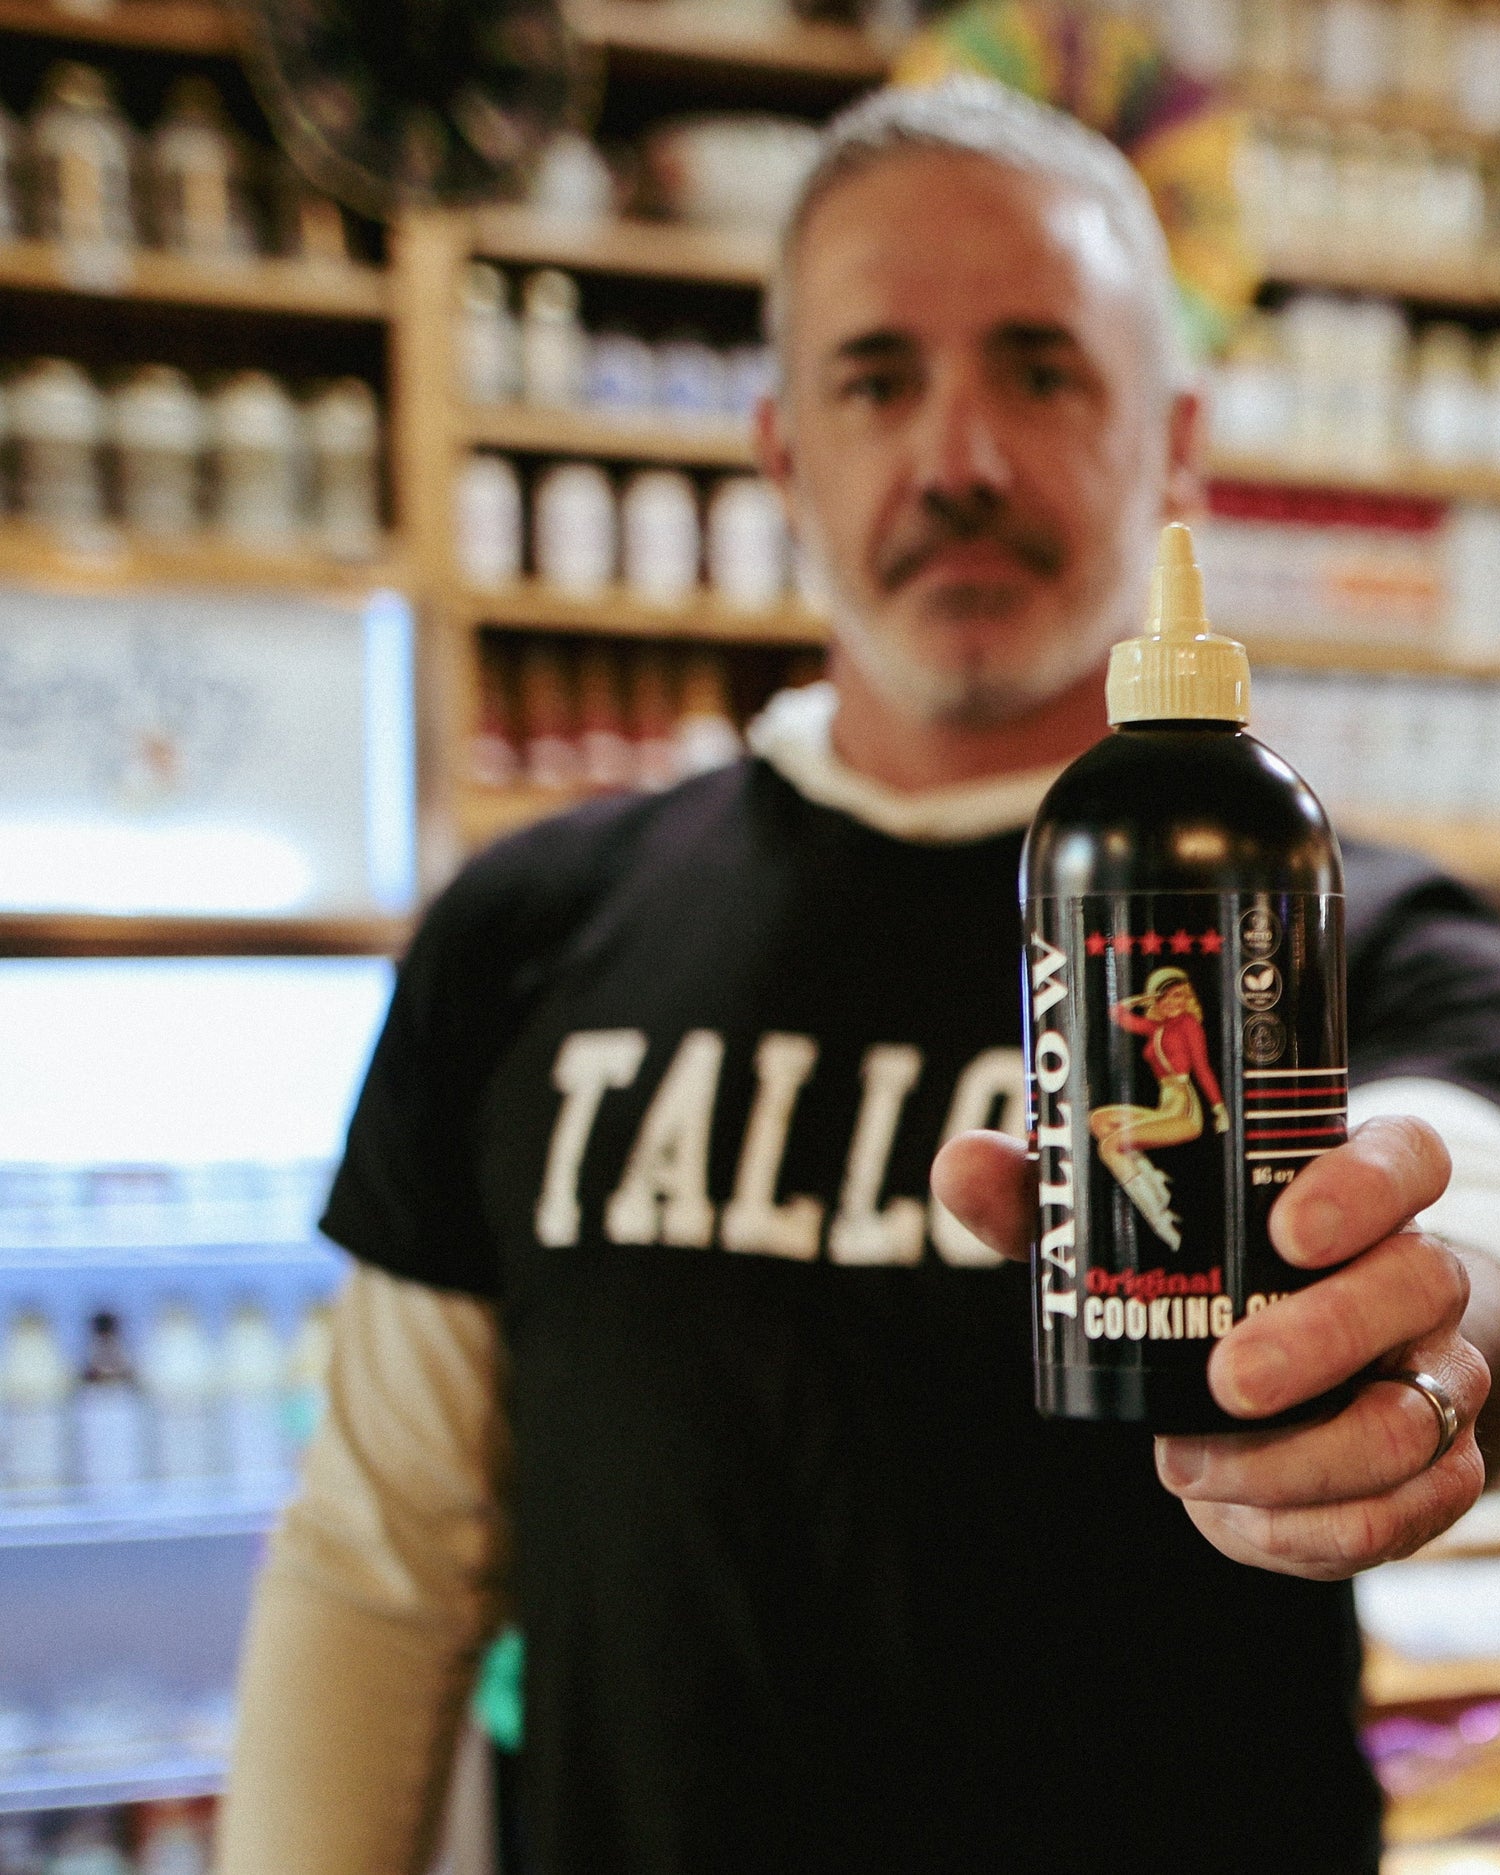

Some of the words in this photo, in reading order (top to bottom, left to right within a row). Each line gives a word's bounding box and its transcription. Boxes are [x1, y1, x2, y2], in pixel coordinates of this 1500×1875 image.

[534, 1026, 1026, 1269] TALLO
[1031, 931, 1078, 1332] TALLOW
[1084, 1266, 1223, 1304] Original
[1084, 1294, 1234, 1341] COOKING
